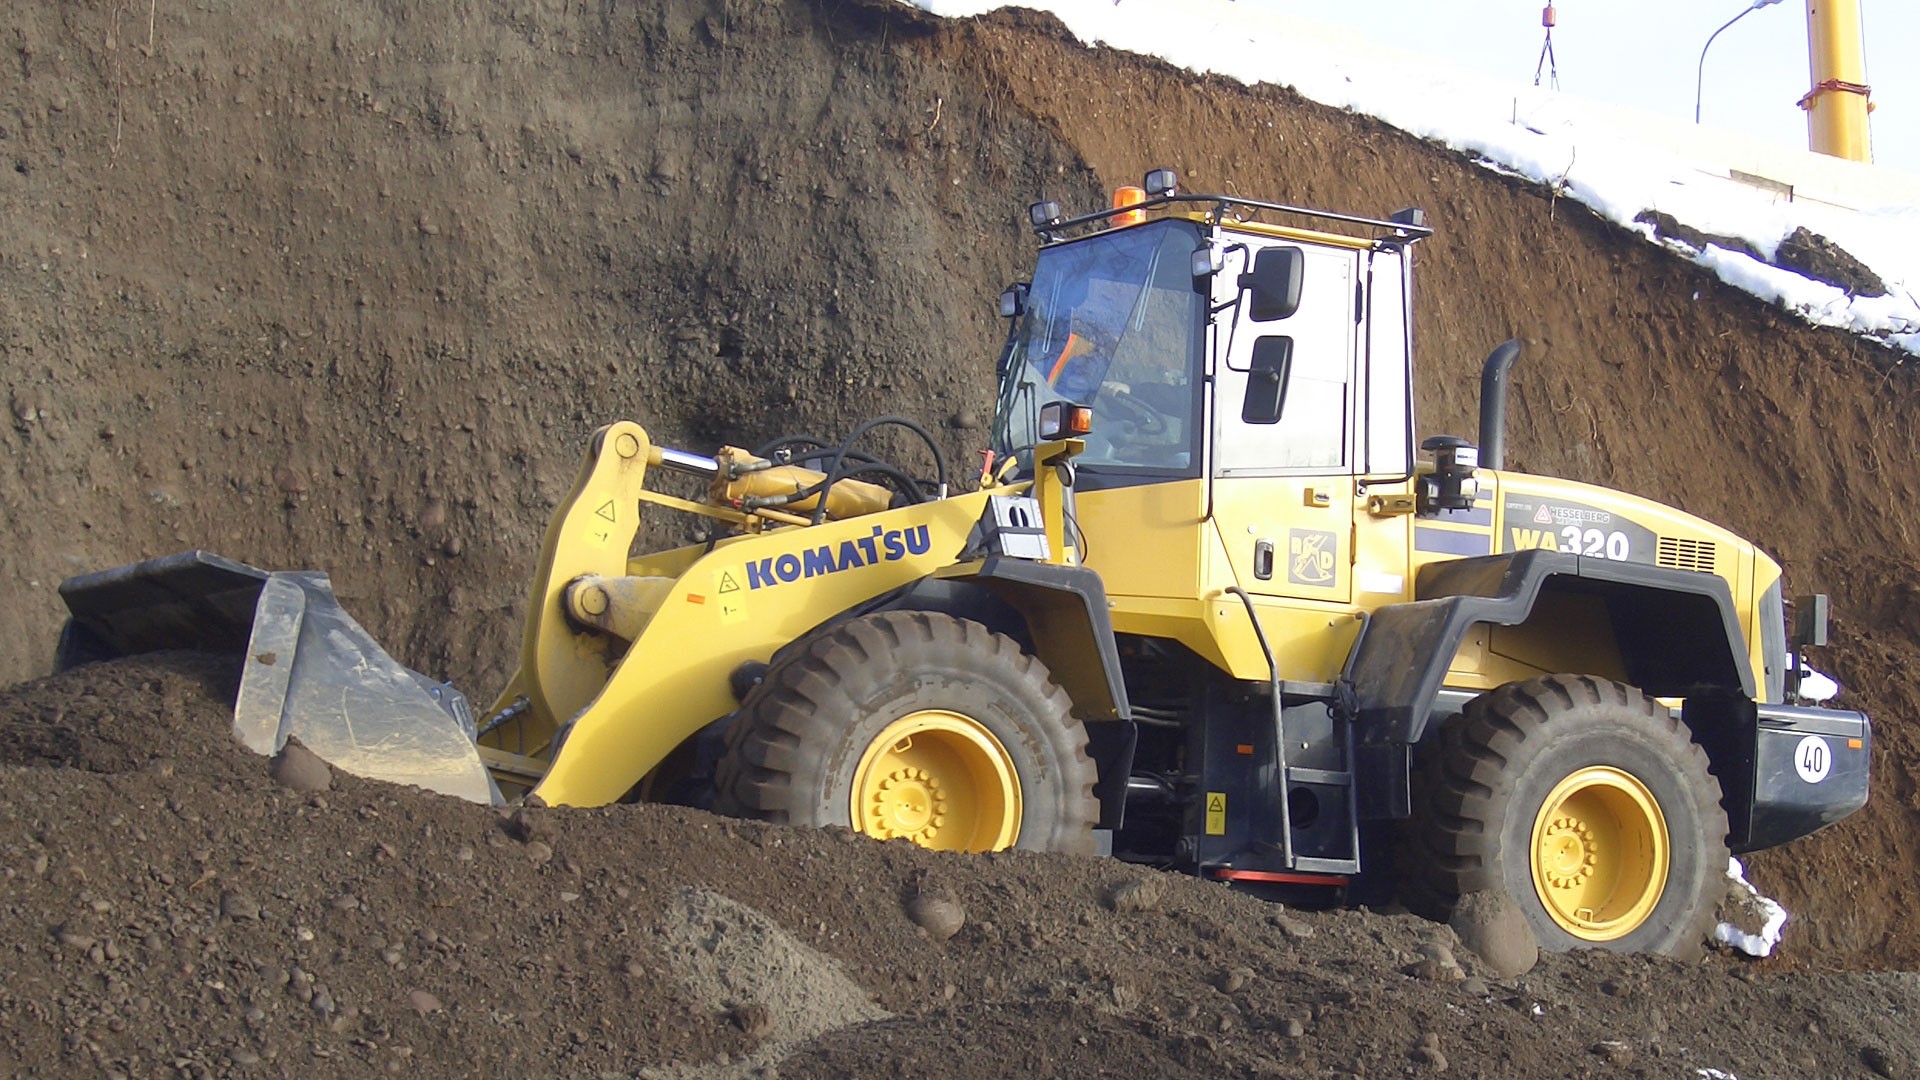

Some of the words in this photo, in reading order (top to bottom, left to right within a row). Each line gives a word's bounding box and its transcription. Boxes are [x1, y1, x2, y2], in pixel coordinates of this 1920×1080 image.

[1550, 507, 1610, 523] HESSELBERG
[746, 525, 931, 590] KOMATSU
[1803, 745, 1823, 773] 40
